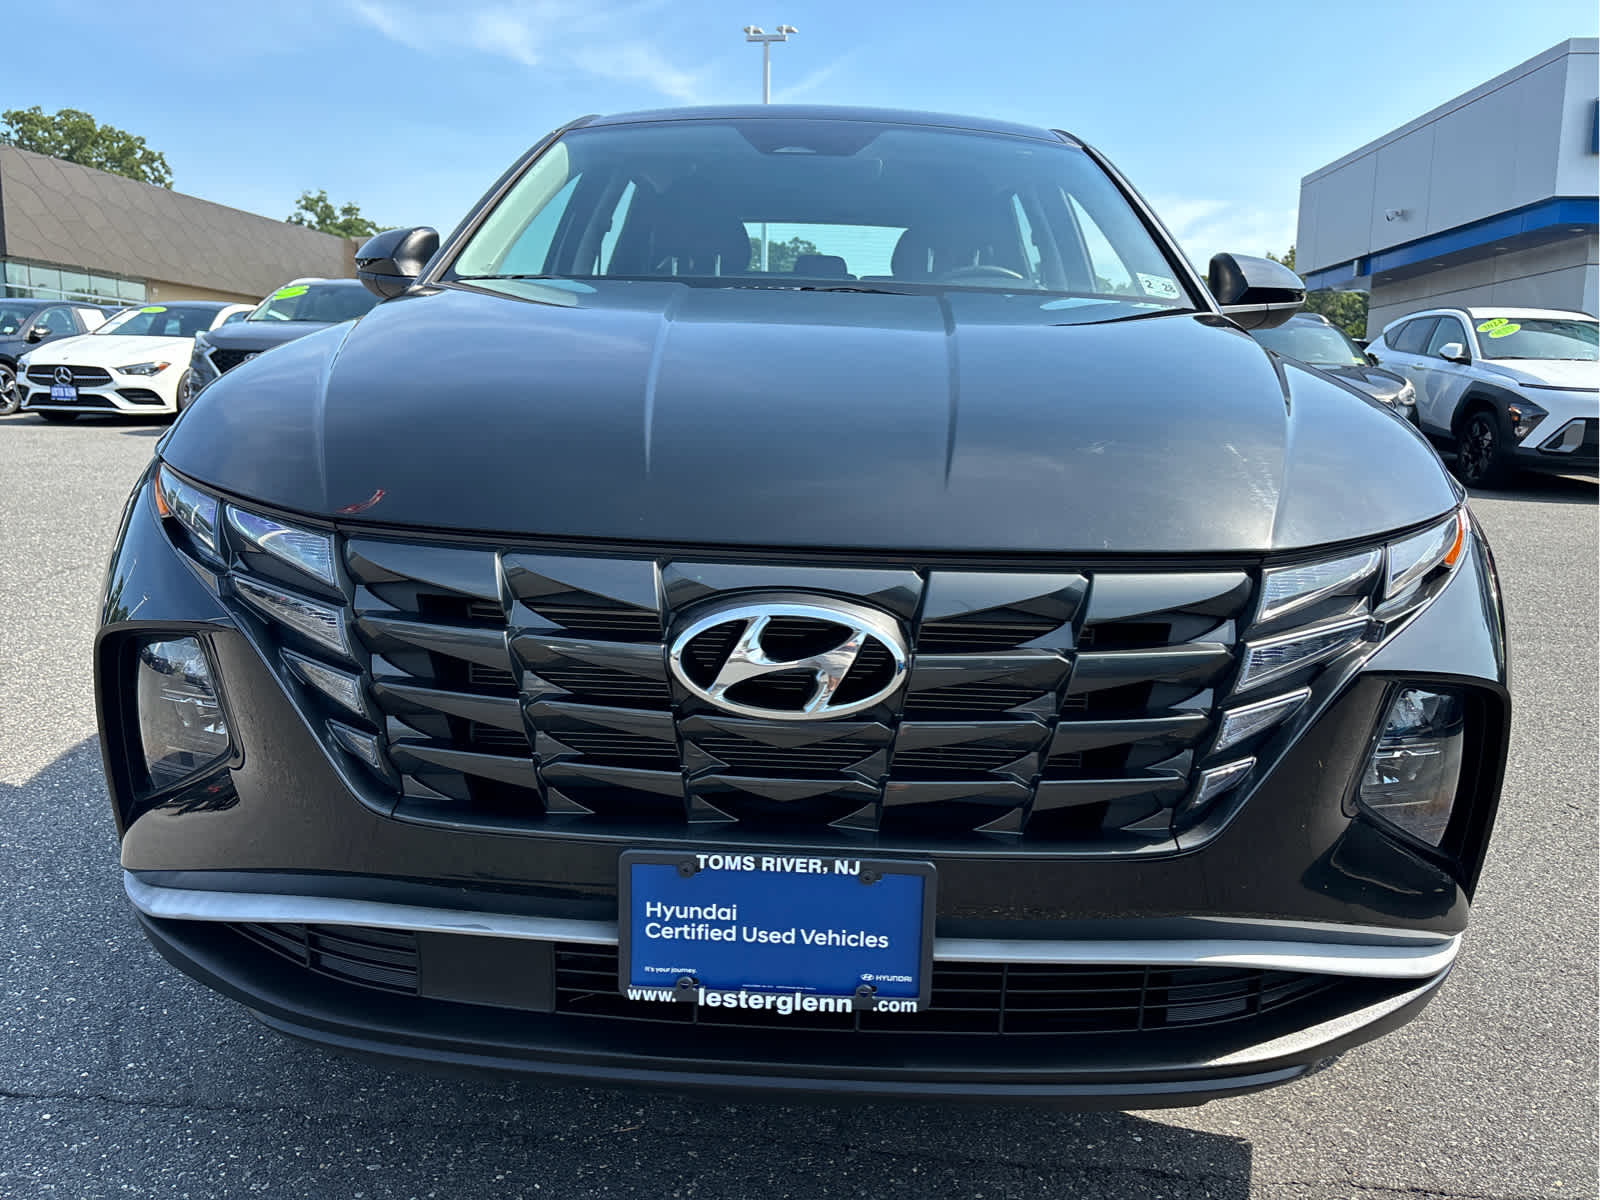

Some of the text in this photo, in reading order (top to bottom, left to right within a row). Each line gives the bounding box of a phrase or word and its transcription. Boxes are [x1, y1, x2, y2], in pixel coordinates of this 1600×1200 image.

[1145, 279, 1153, 289] 2
[696, 854, 861, 875] TOMS RIVER, NJ
[645, 901, 737, 921] Hyundai
[645, 923, 889, 948] Certified Used Vehicles
[875, 974, 913, 983] HYUNDAI
[627, 988, 918, 1014] www. lesterglenn .com
